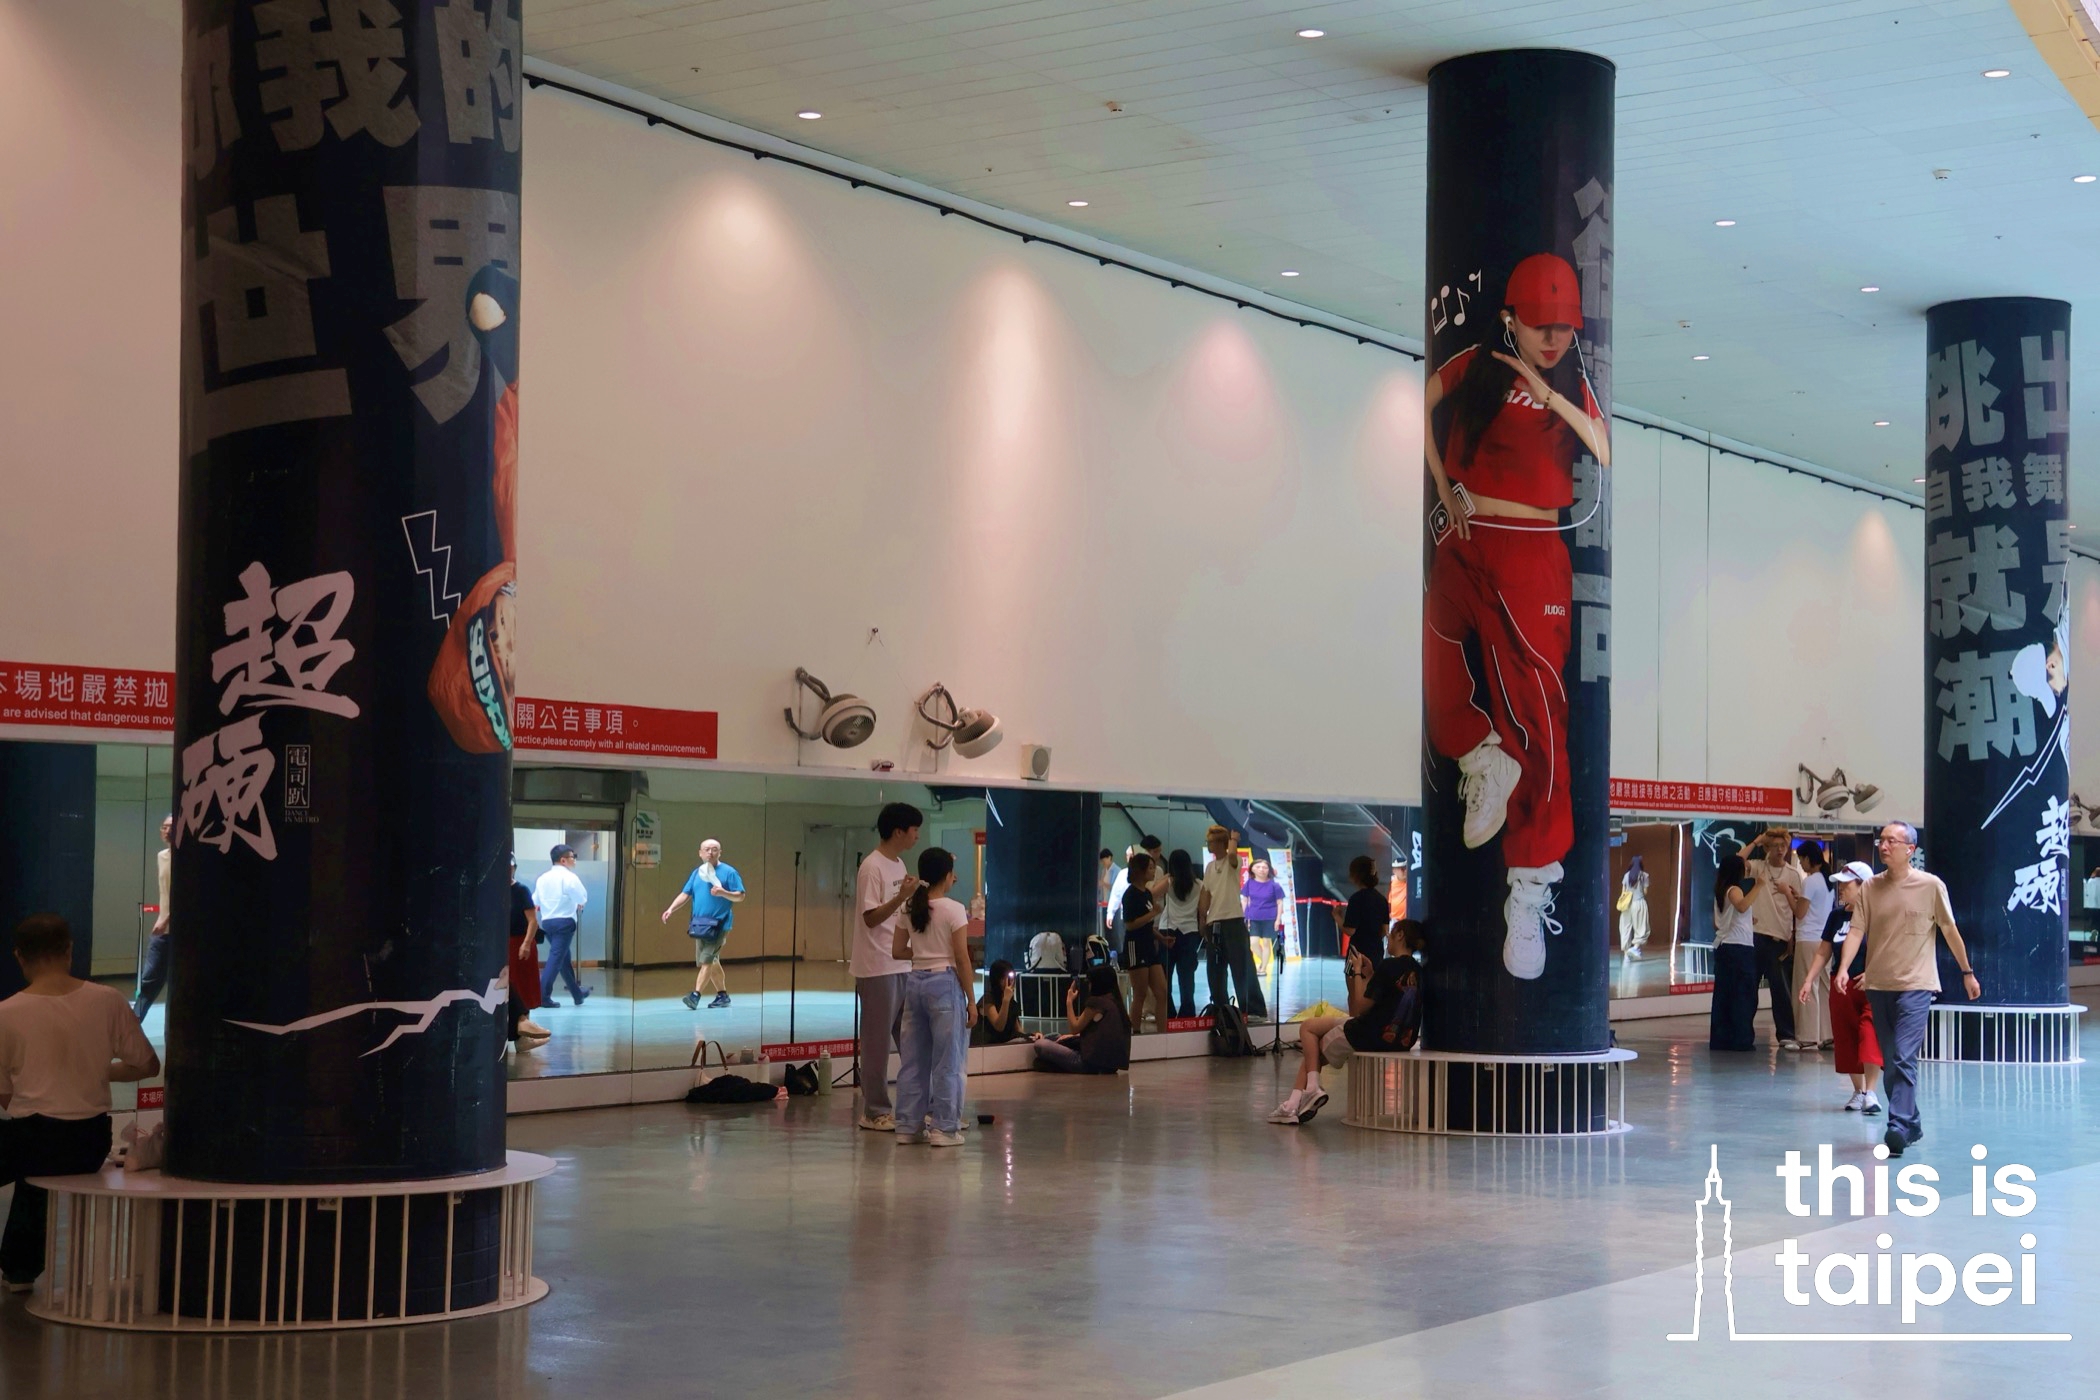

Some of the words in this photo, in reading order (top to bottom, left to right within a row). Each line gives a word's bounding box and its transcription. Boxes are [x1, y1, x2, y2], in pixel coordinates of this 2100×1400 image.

[3, 708, 21, 717] are
[24, 707, 67, 720] advised
[70, 709, 91, 721] that
[94, 711, 149, 725] dangerous
[513, 735, 567, 747] ractice,please
[569, 738, 596, 750] comply
[598, 739, 613, 749] with
[615, 740, 624, 750] all
[625, 741, 649, 751] related
